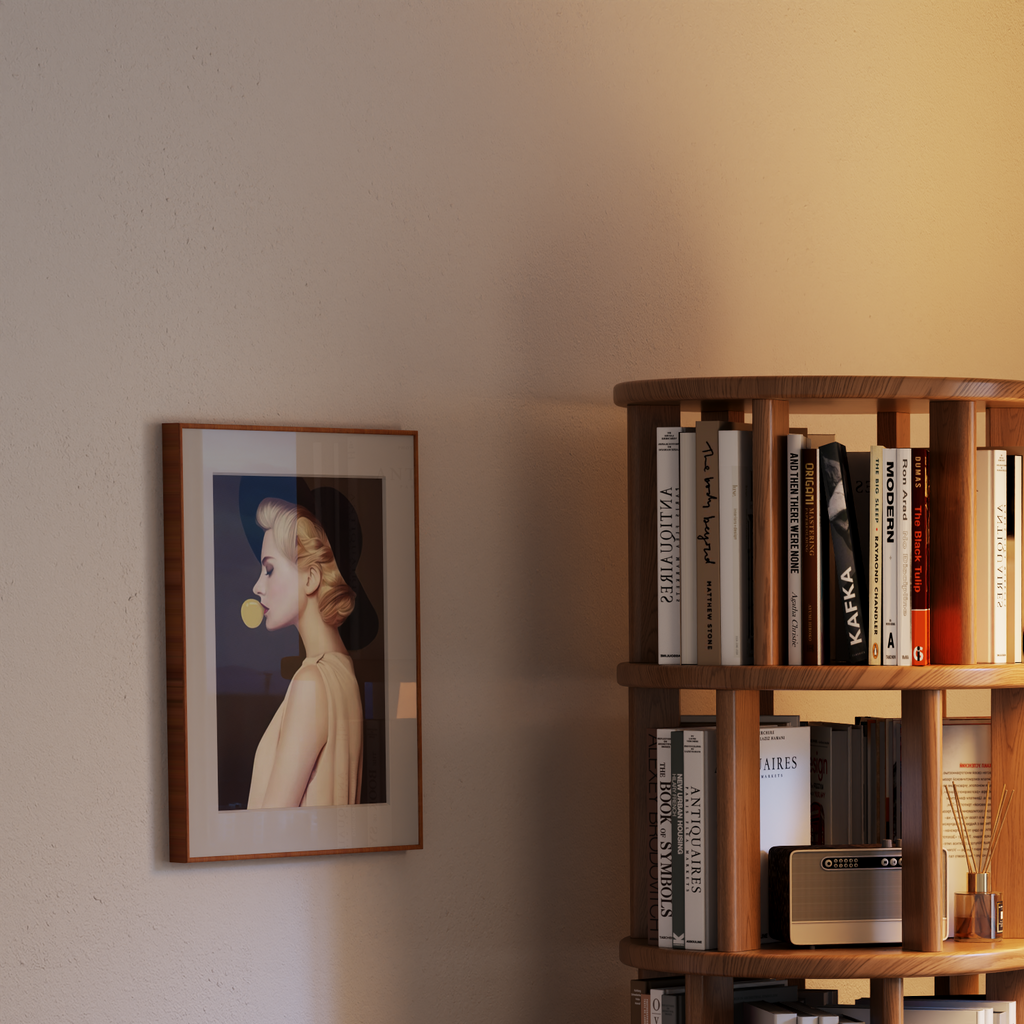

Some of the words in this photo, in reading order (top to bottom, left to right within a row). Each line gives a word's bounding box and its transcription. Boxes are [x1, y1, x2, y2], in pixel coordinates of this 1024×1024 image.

[702, 441, 712, 473] The
[790, 452, 799, 471] AND
[702, 476, 718, 509] body
[790, 473, 799, 495] THEN
[804, 462, 814, 505] ORIGAMI
[790, 496, 799, 524] THERE
[886, 462, 894, 543] MODERN
[914, 506, 922, 529] The
[698, 516, 716, 566] beyond
[790, 525, 800, 550] WERE
[914, 530, 922, 562] Black
[791, 550, 800, 574] NONE
[913, 564, 922, 593] Tulip
[840, 566, 864, 646] KAFKA
[660, 782, 672, 824] BOOK
[660, 828, 666, 838] OF
[687, 786, 702, 894] ANTIQUAIRES
[660, 841, 673, 918] SYMBOLS
